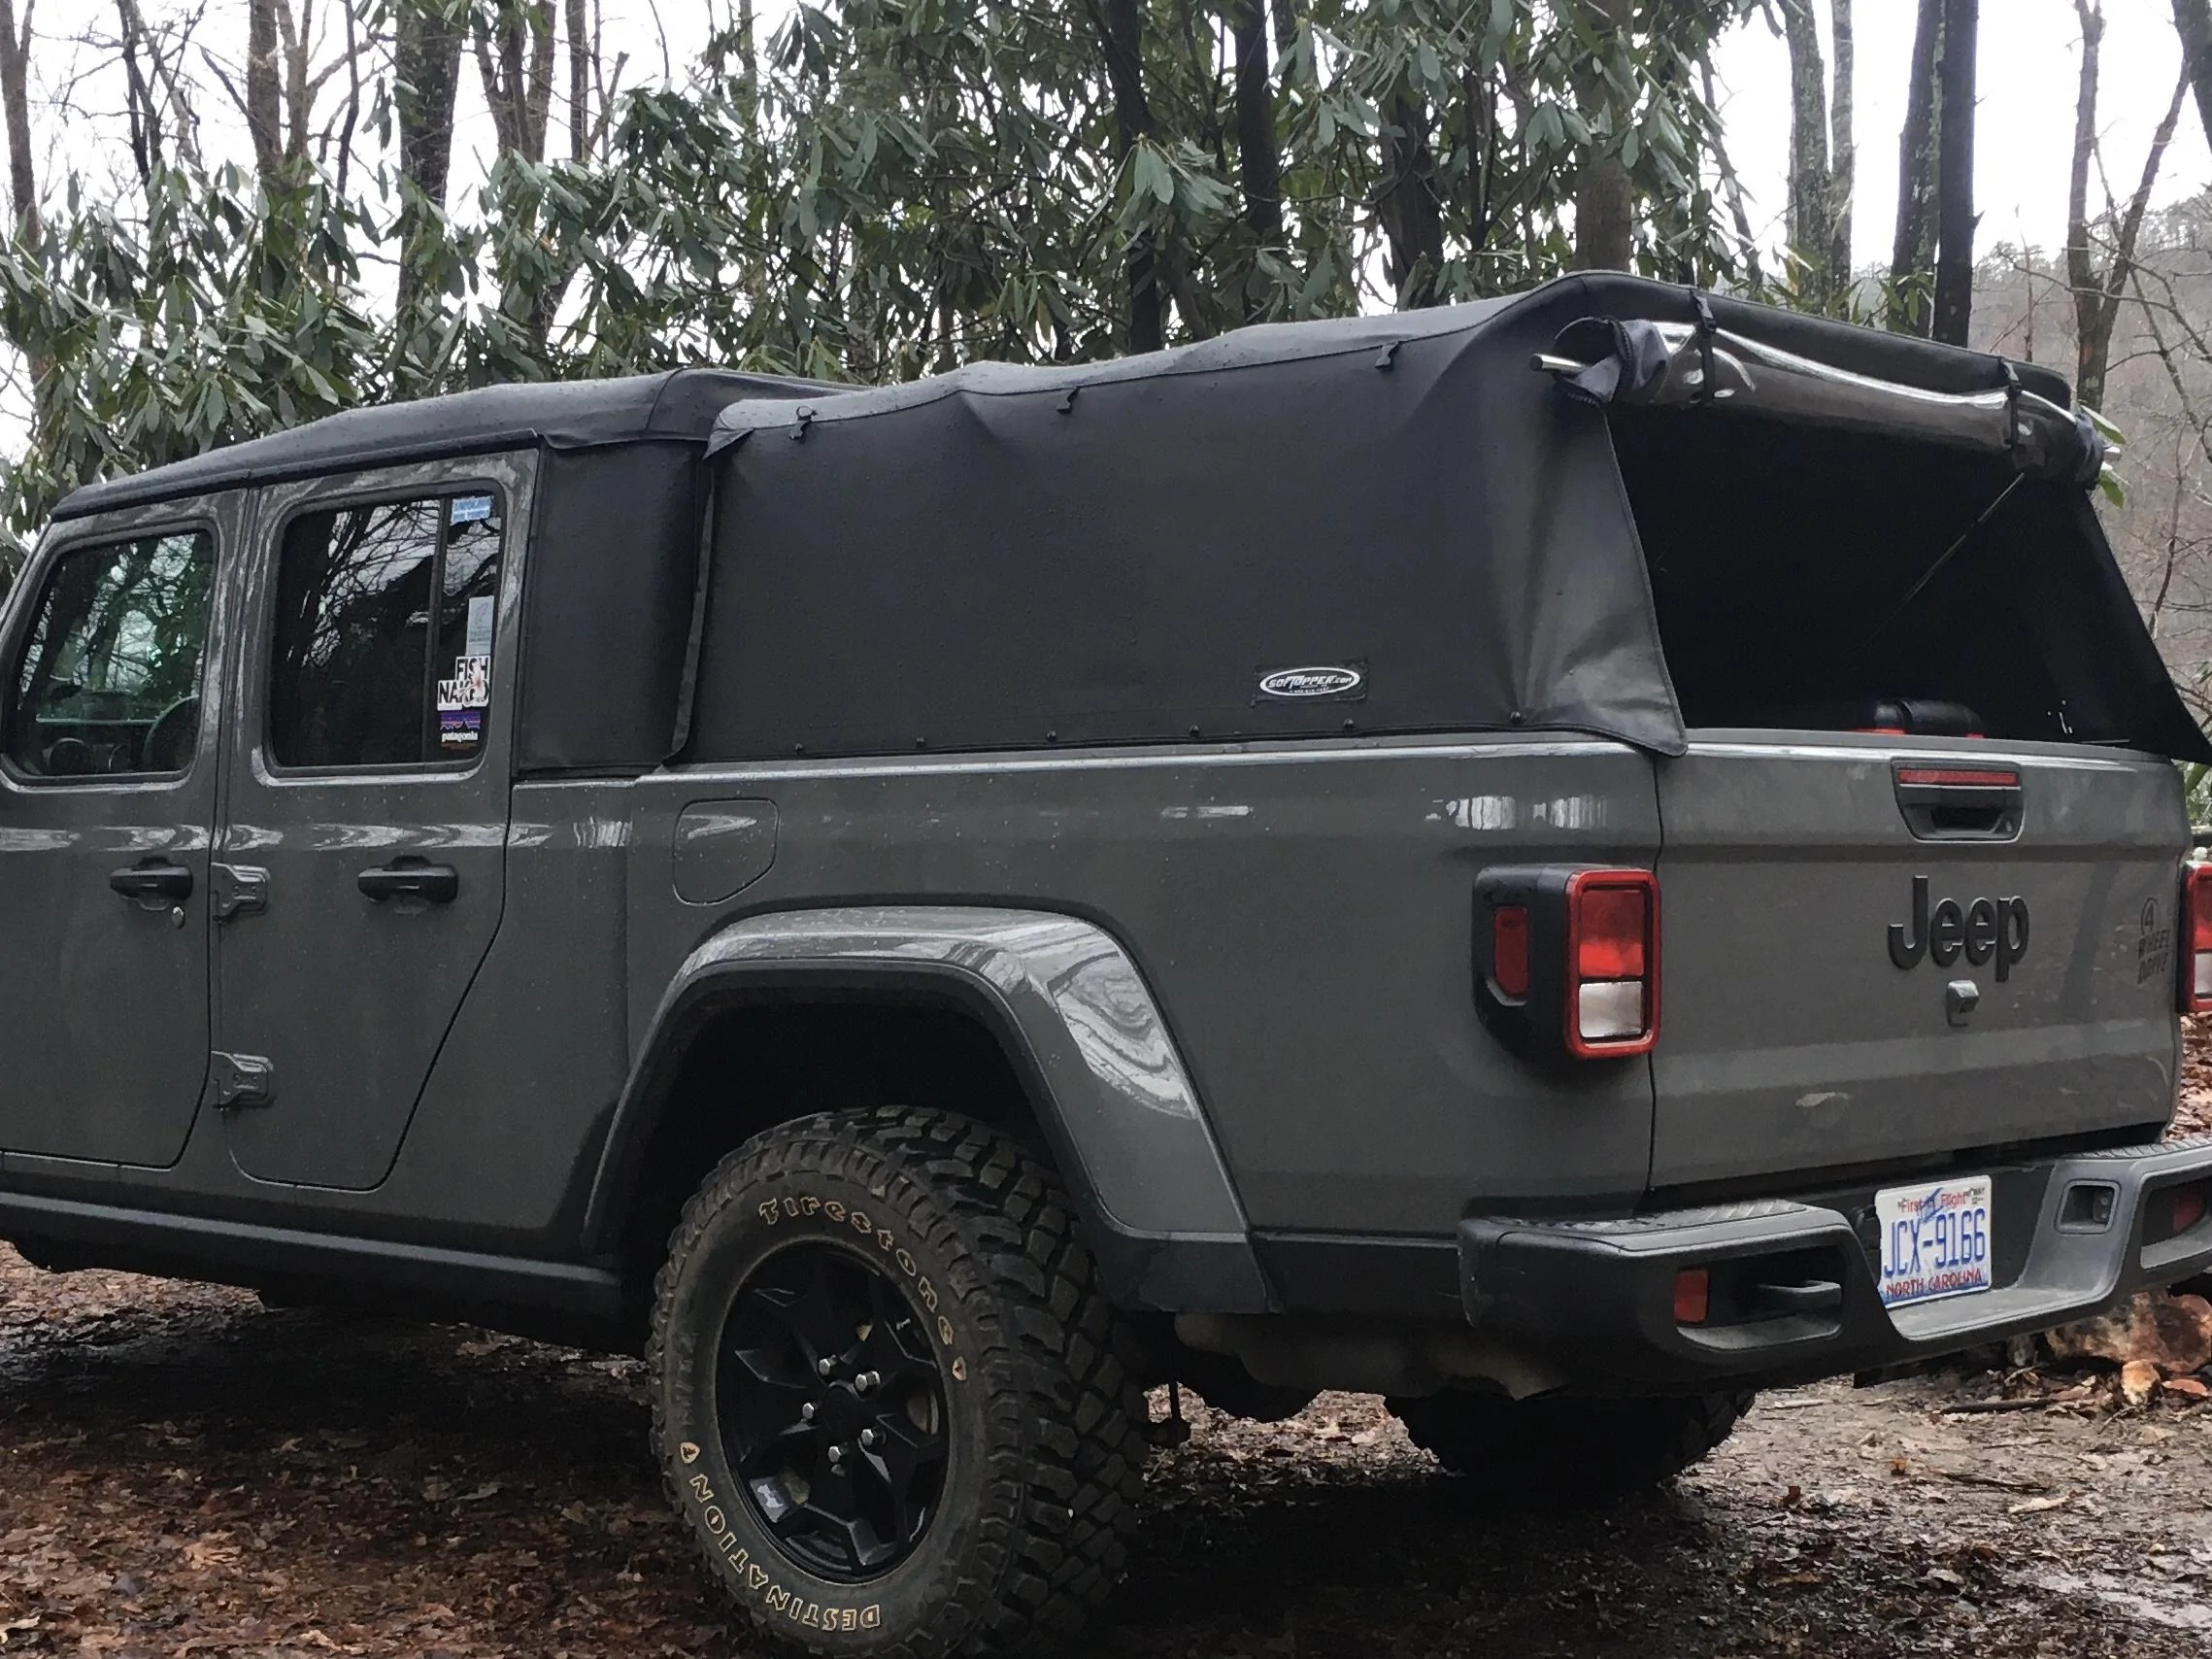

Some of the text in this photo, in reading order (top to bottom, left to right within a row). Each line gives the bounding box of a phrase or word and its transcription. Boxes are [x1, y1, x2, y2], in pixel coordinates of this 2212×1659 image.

[441, 730, 479, 743] patagonia
[1888, 874, 2029, 982] Jeep
[1940, 1191, 1966, 1208] Flight
[1884, 1207, 1986, 1278] JCX-9166
[1886, 1267, 1983, 1298] NORTH CAROLINA
[689, 1473, 882, 1632] DESTINATION
